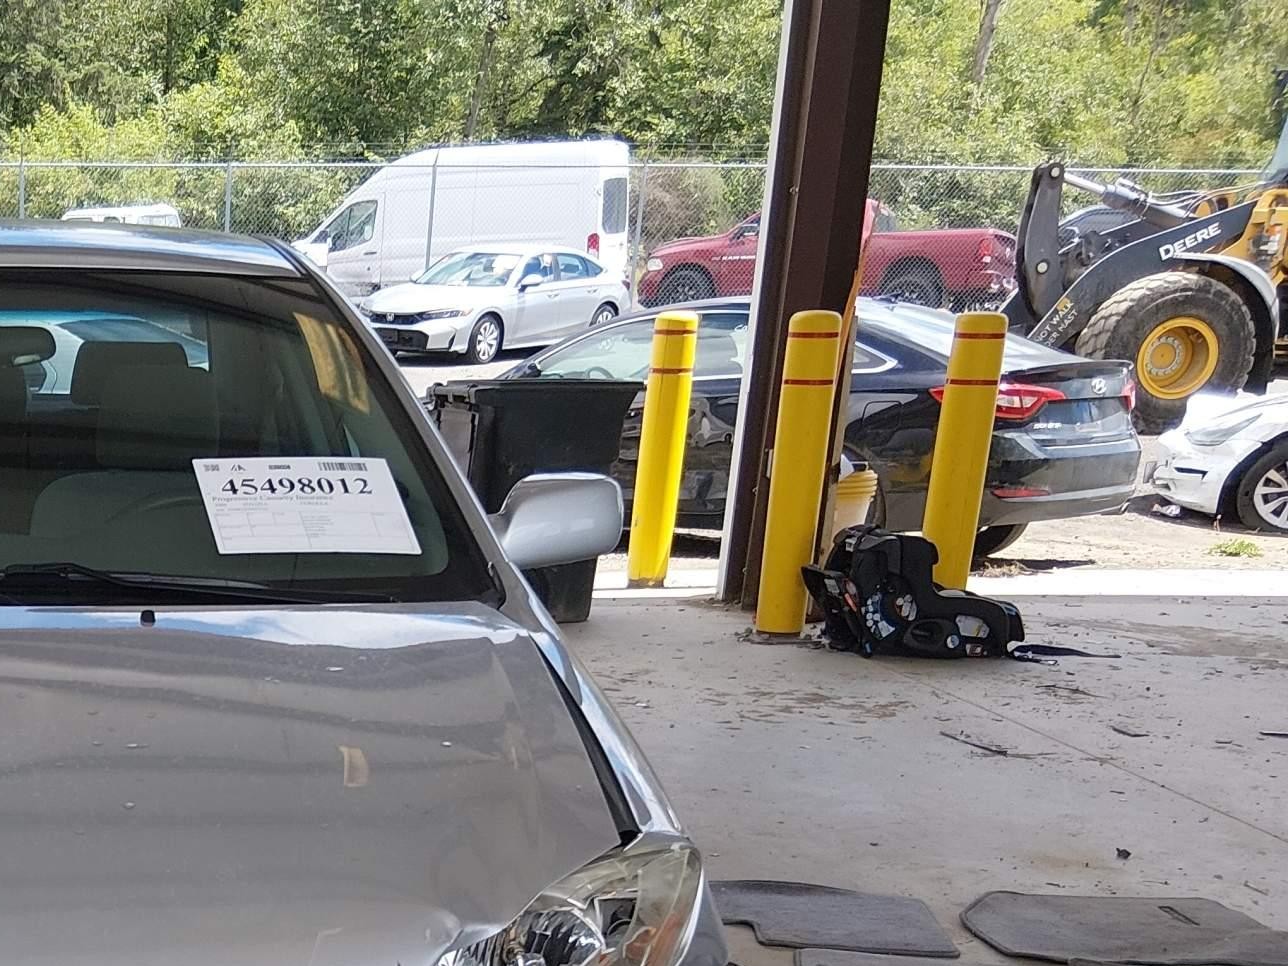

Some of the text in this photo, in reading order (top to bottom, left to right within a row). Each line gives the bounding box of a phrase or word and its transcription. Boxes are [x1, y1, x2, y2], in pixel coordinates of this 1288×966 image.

[1158, 222, 1222, 262] DEERE
[1049, 302, 1075, 325] WALK
[221, 477, 373, 495] 45498012
